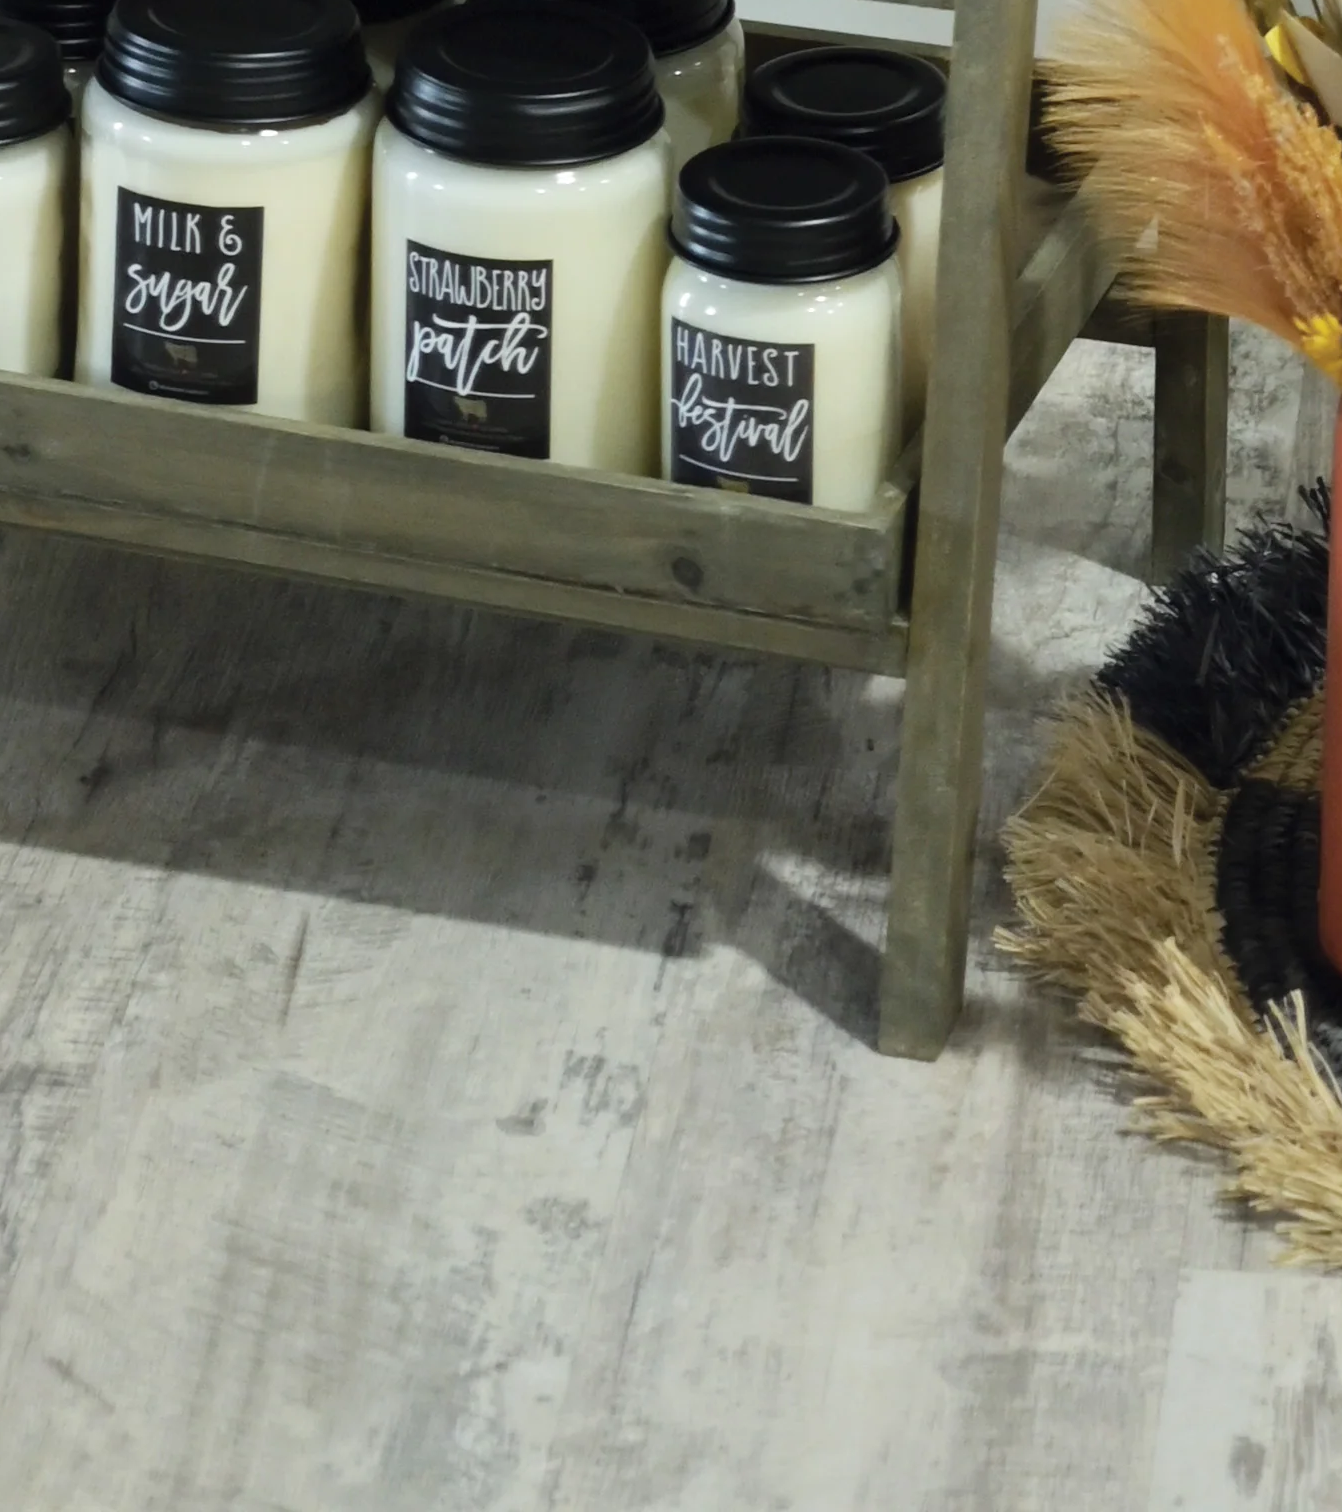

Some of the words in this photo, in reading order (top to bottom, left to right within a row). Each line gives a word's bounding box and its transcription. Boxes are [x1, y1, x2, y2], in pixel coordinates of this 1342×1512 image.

[133, 202, 202, 254] MILK
[219, 214, 243, 256] &
[125, 262, 249, 332] sugar
[409, 251, 547, 312] STRAWBERRY
[407, 312, 549, 396] patch
[676, 326, 800, 388] HARVEST
[670, 373, 809, 462] festival
